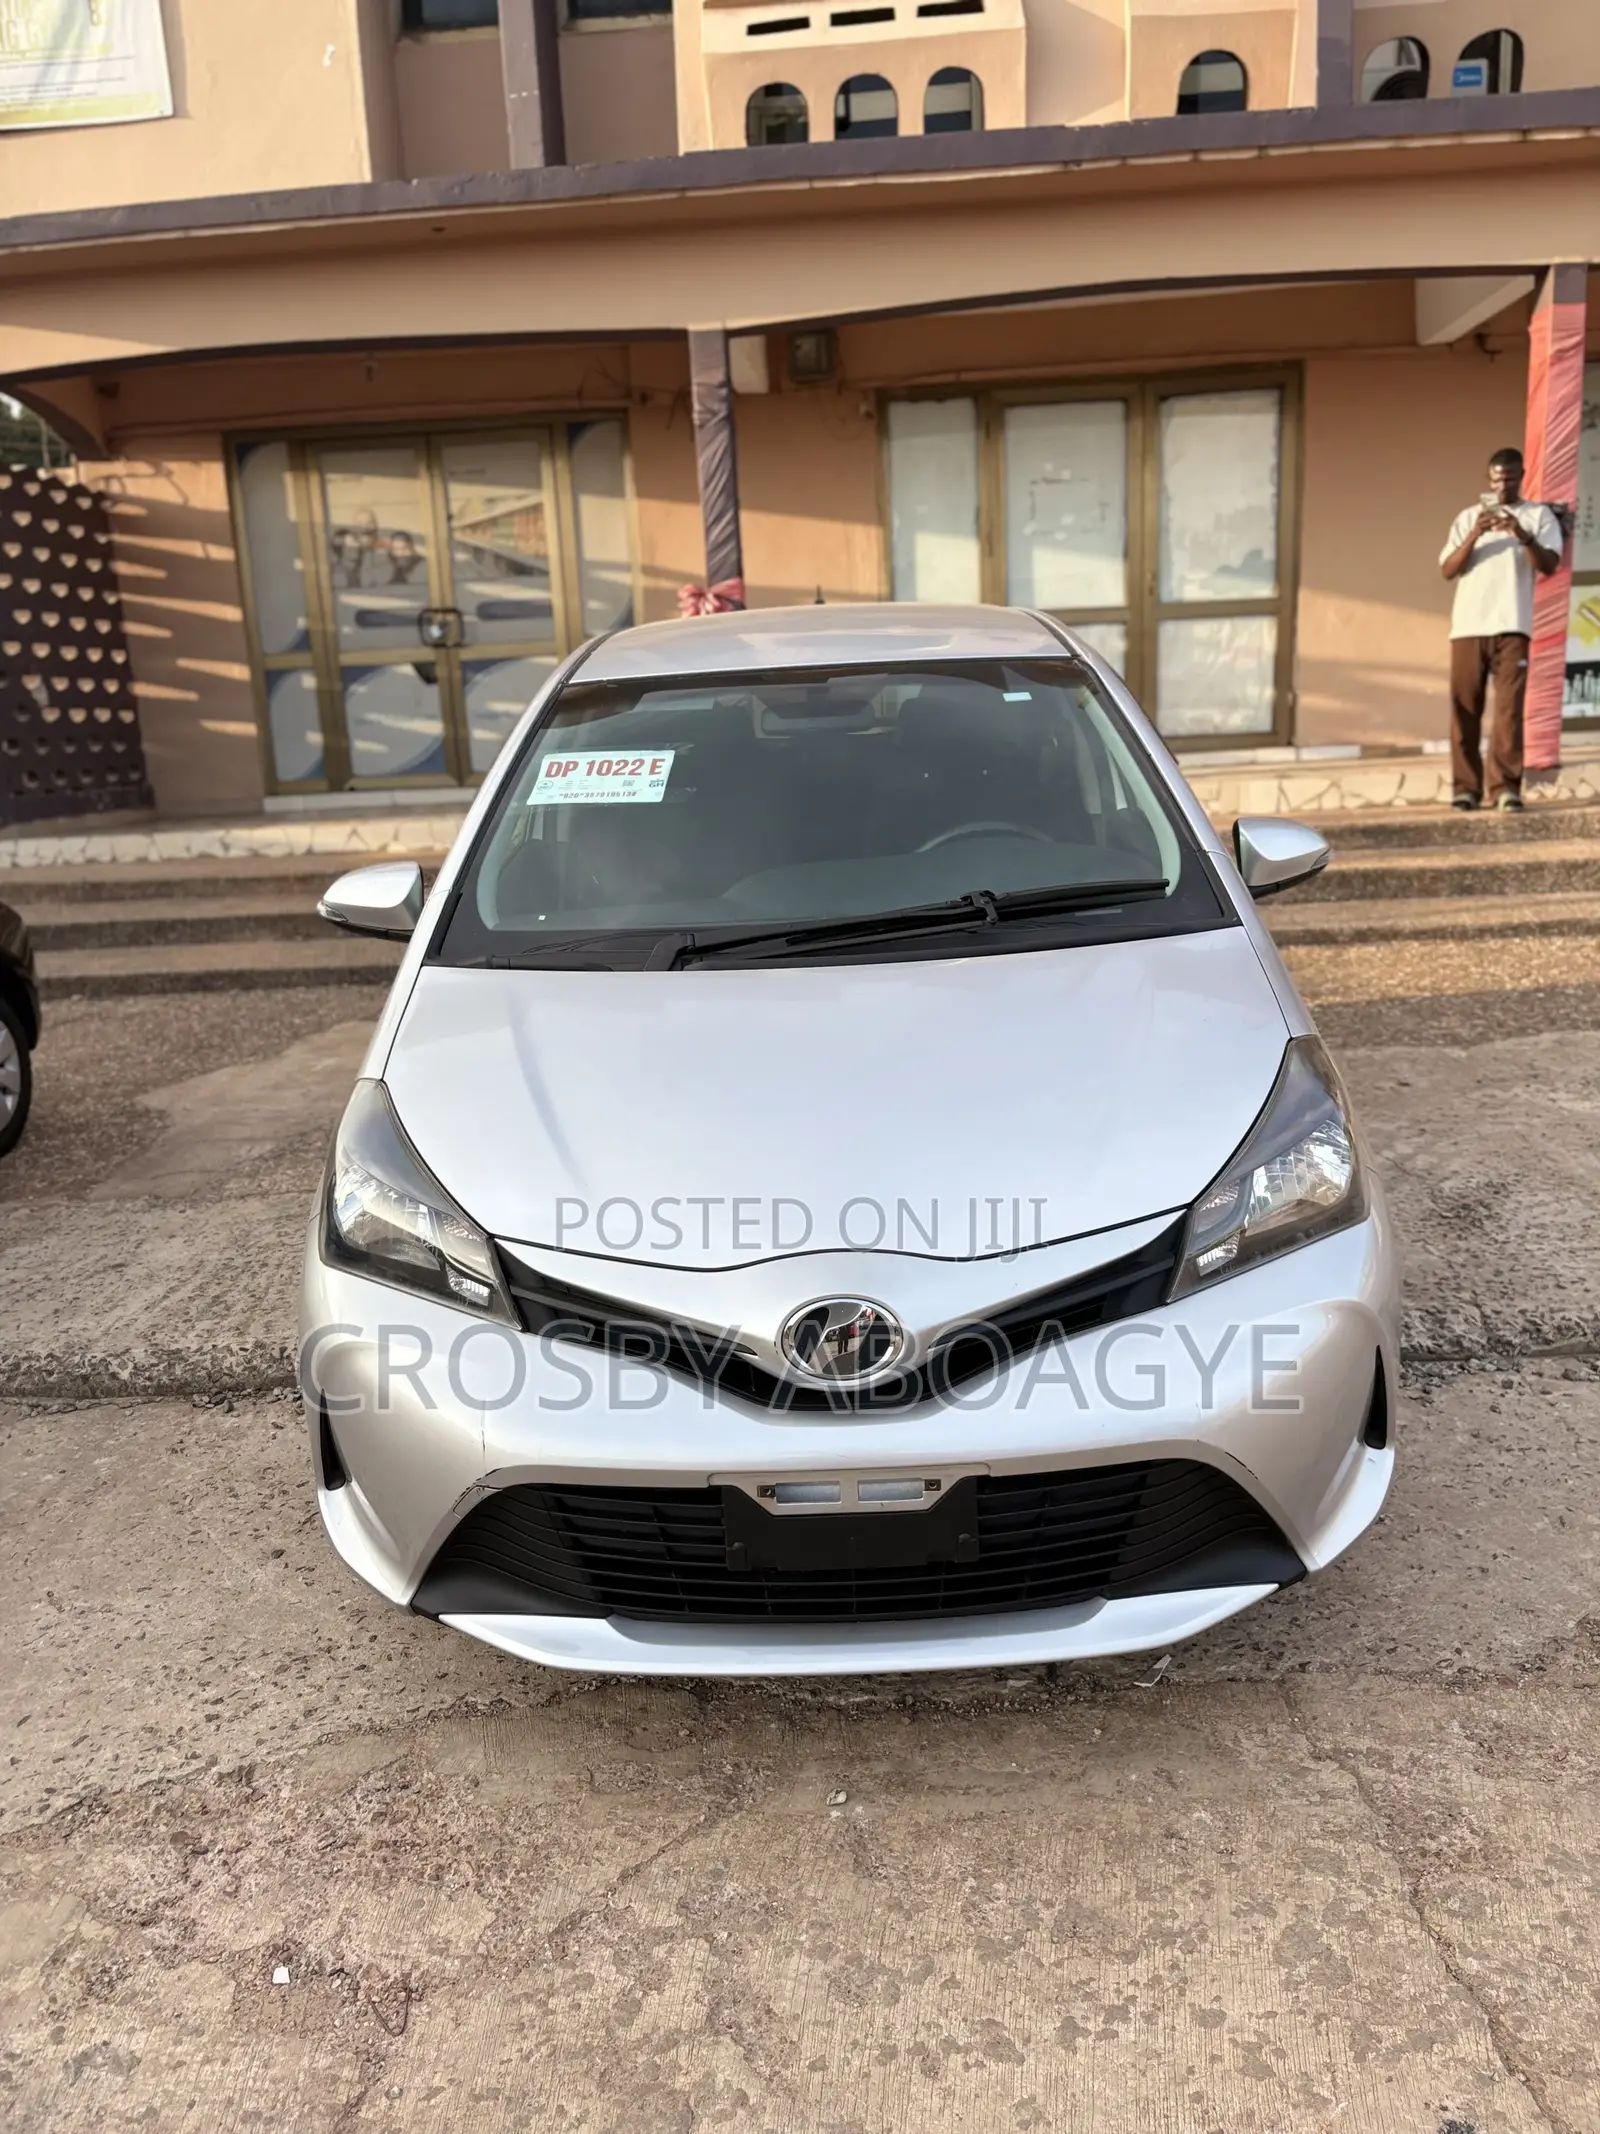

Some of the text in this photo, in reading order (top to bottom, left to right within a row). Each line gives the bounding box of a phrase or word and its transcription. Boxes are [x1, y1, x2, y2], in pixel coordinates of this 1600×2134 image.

[545, 758, 666, 778] DP 1022 E
